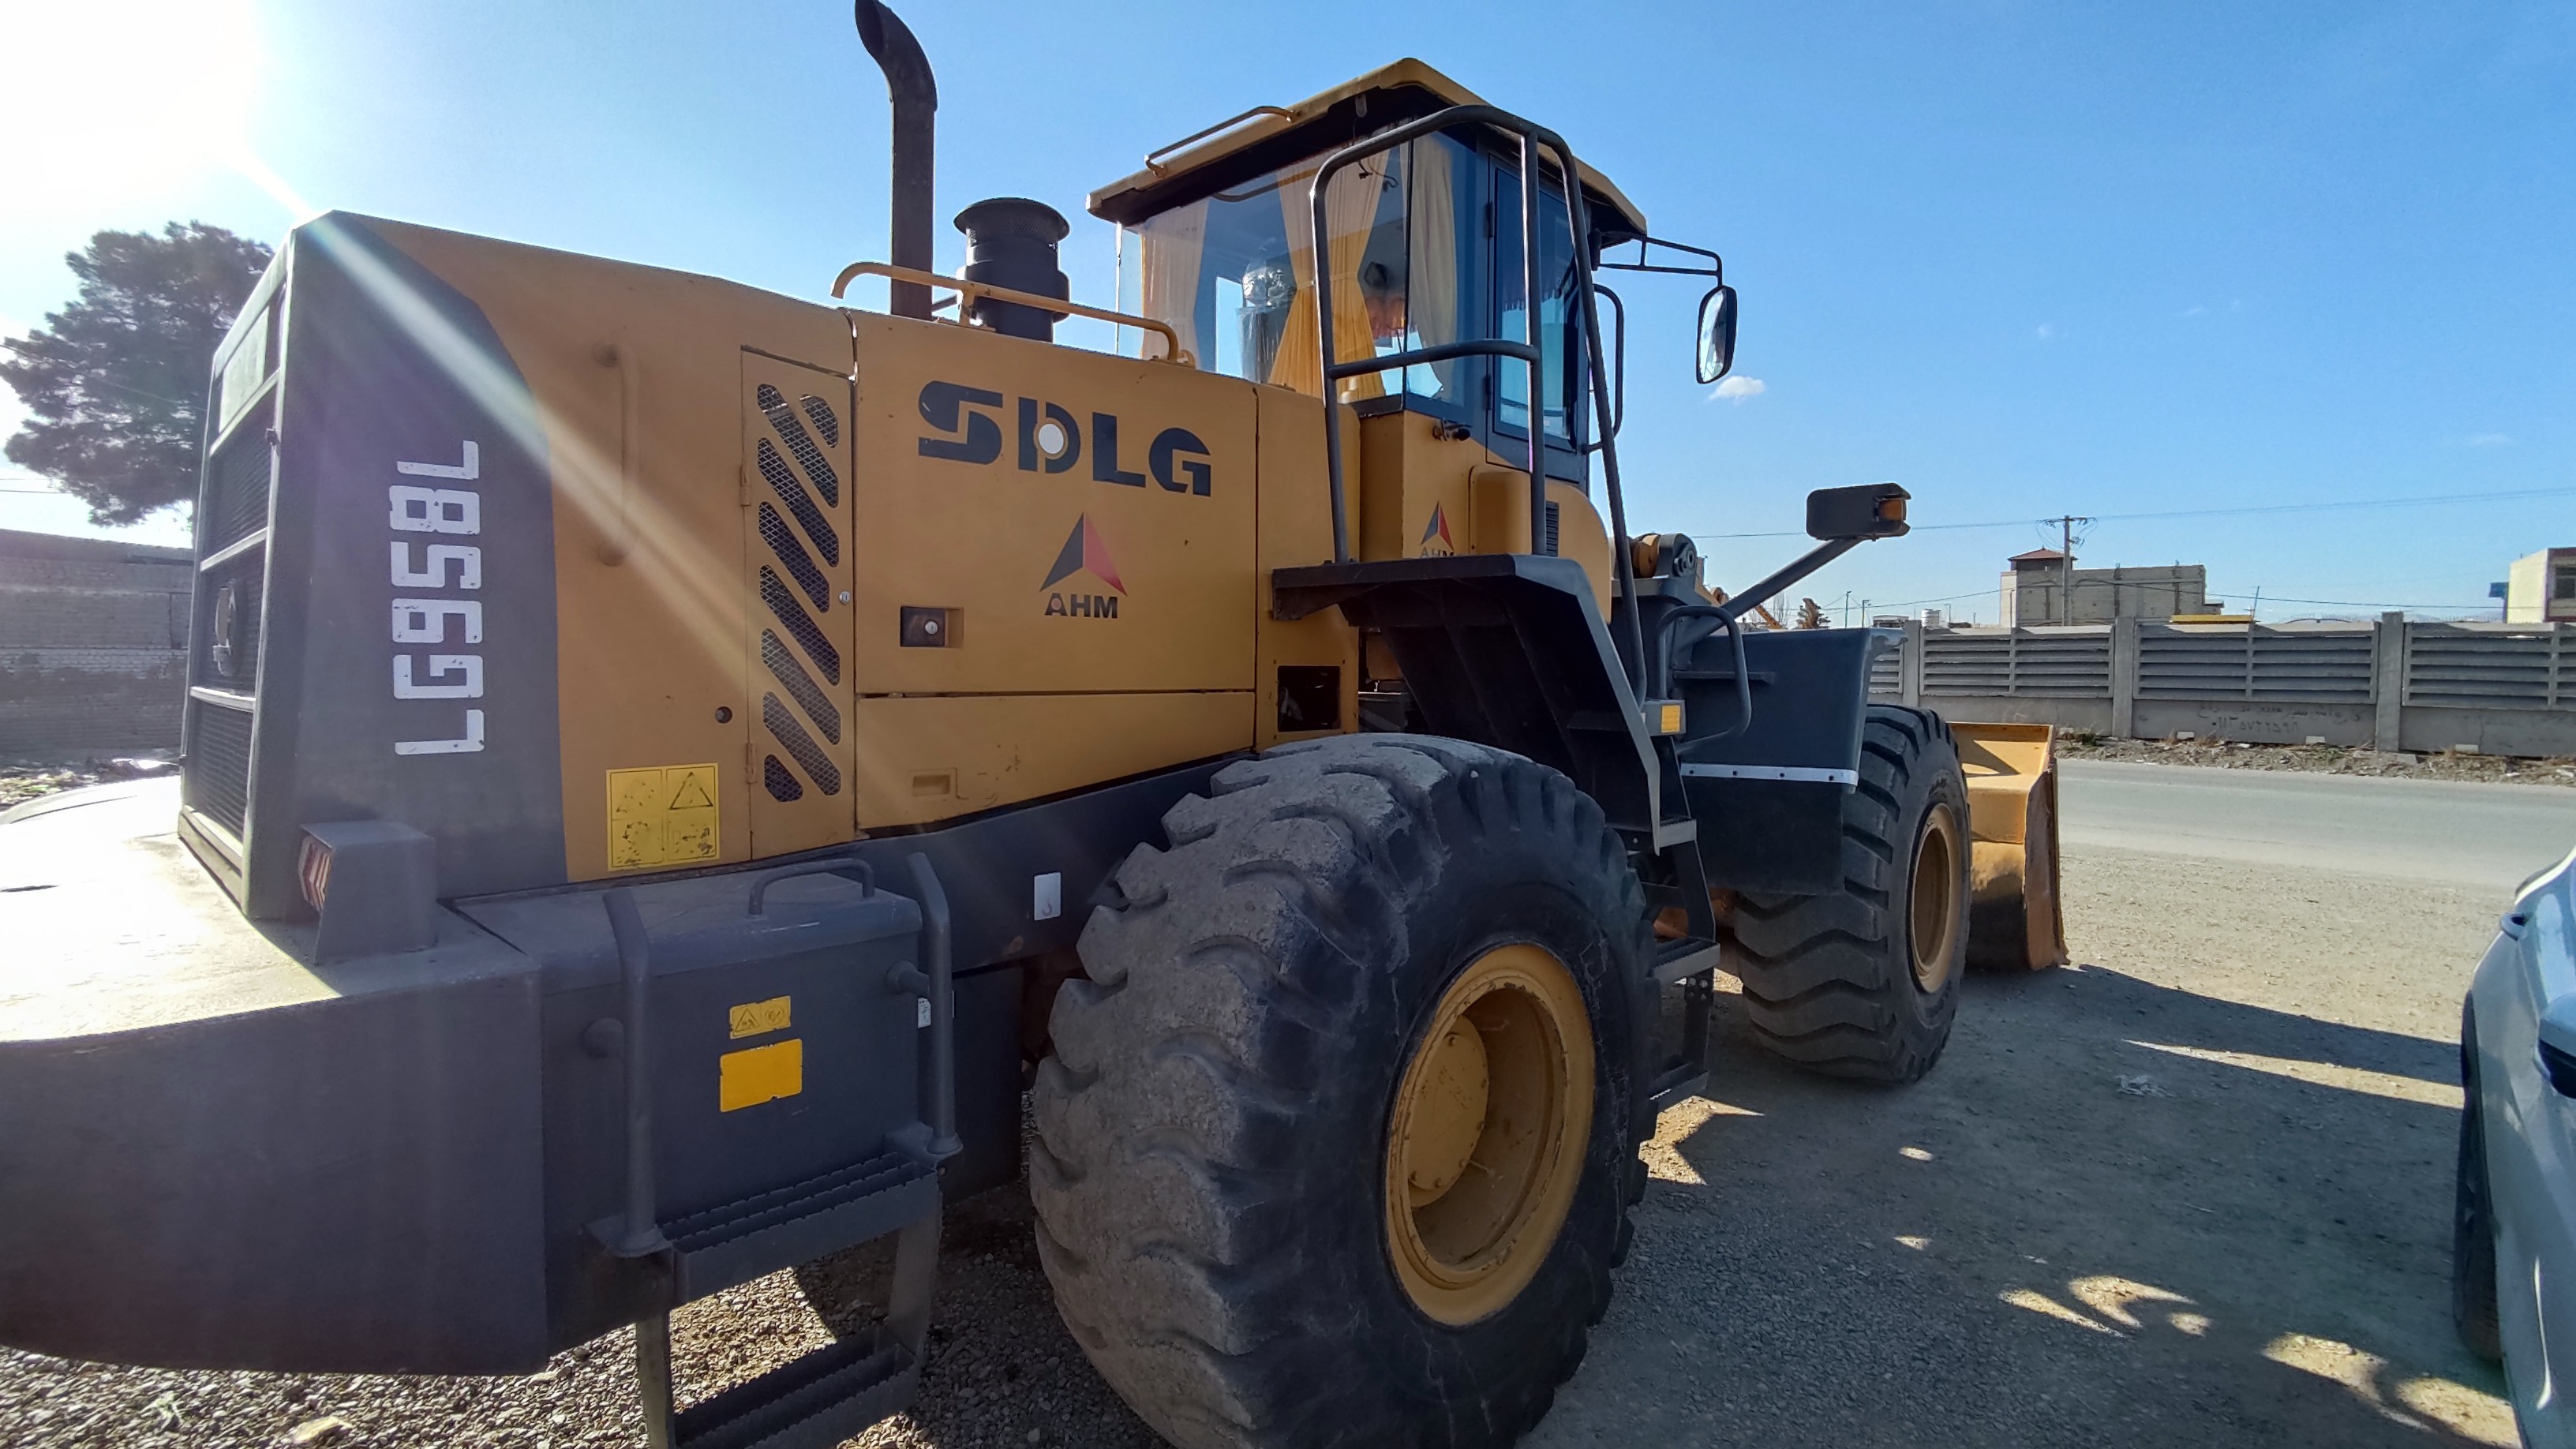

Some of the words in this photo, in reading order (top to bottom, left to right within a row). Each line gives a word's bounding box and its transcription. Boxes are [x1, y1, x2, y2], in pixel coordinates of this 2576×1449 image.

[918, 380, 1211, 497] SDLG
[389, 440, 485, 755] LG958L
[1044, 593, 1118, 620] AHM
